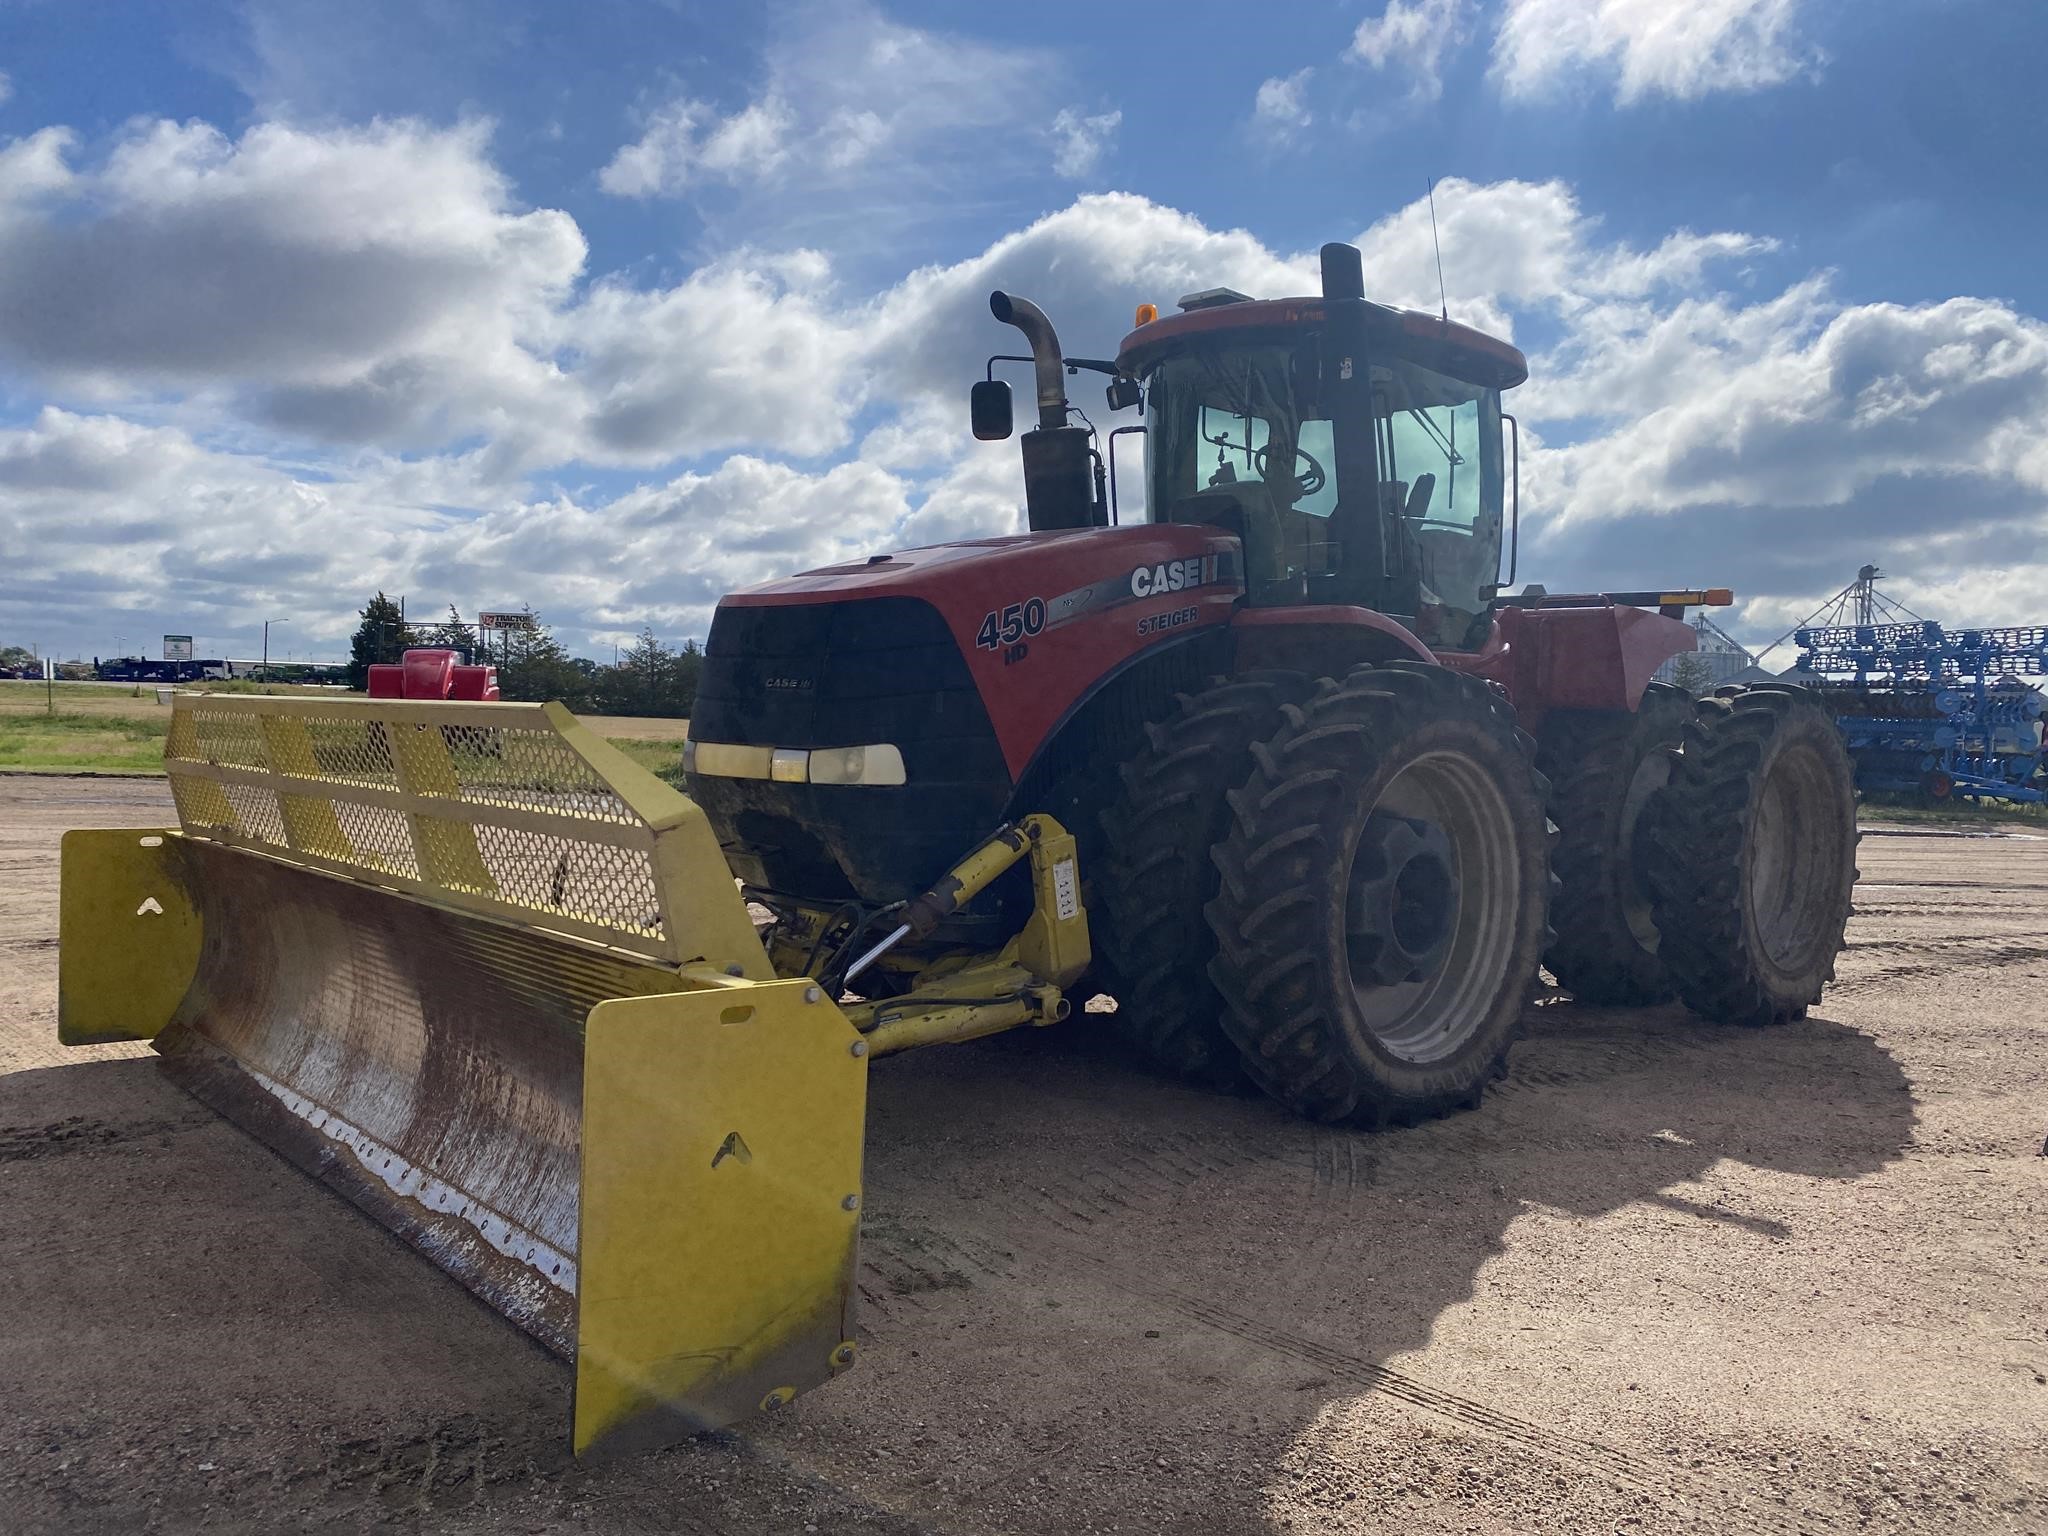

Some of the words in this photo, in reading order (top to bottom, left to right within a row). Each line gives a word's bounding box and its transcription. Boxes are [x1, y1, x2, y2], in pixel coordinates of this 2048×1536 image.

[1130, 558, 1199, 598] CASE
[976, 597, 1047, 651] 450
[1137, 606, 1199, 635] STEIGER
[1004, 642, 1028, 666] HD
[766, 678, 798, 688] CASE
